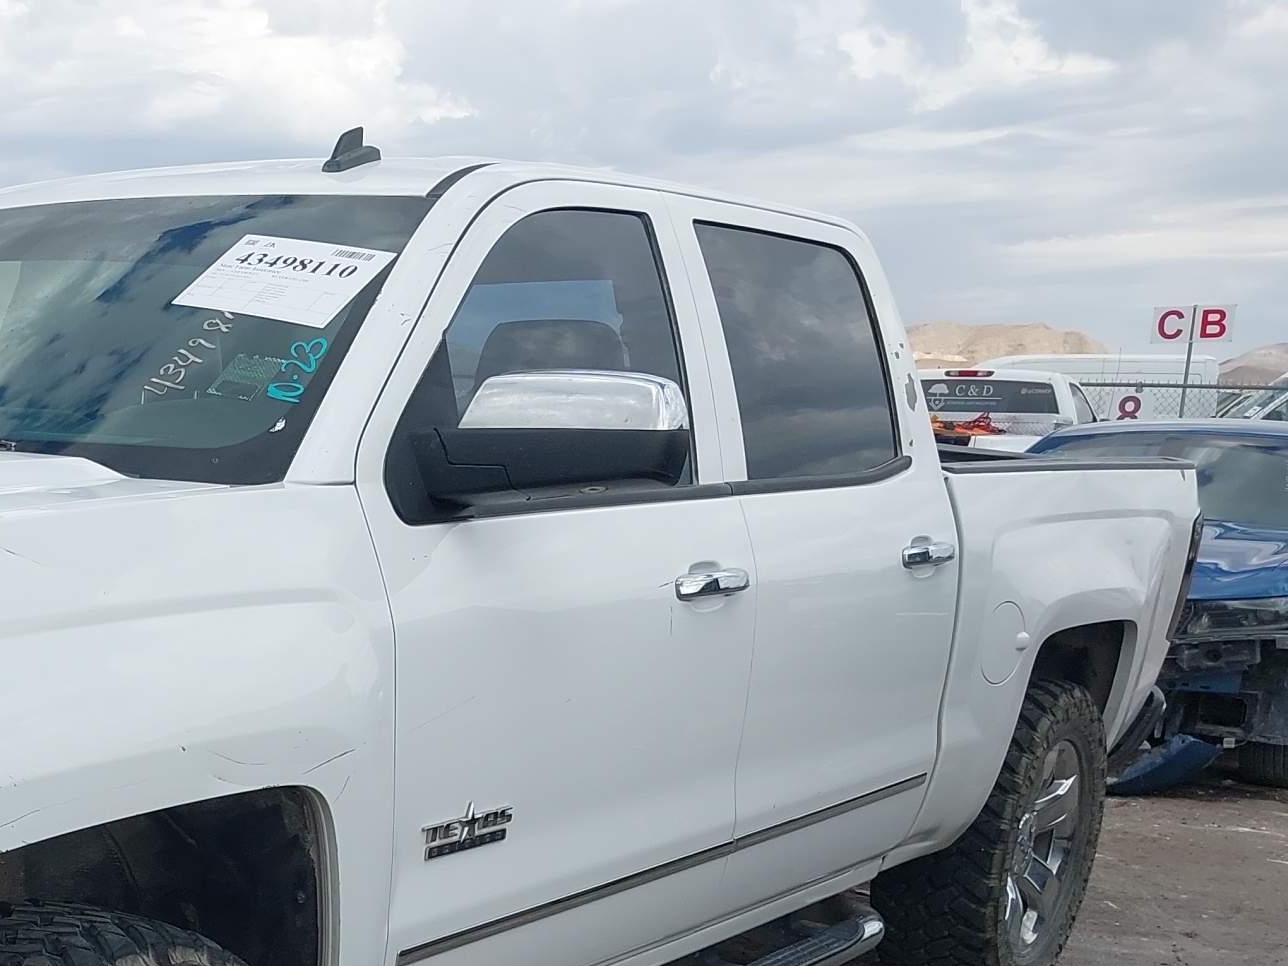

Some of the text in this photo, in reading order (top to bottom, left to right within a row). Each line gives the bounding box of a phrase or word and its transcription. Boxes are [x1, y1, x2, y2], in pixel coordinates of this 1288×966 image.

[235, 251, 358, 279] 43498110
[1158, 309, 1227, 339] C B
[955, 384, 994, 397] C & D
